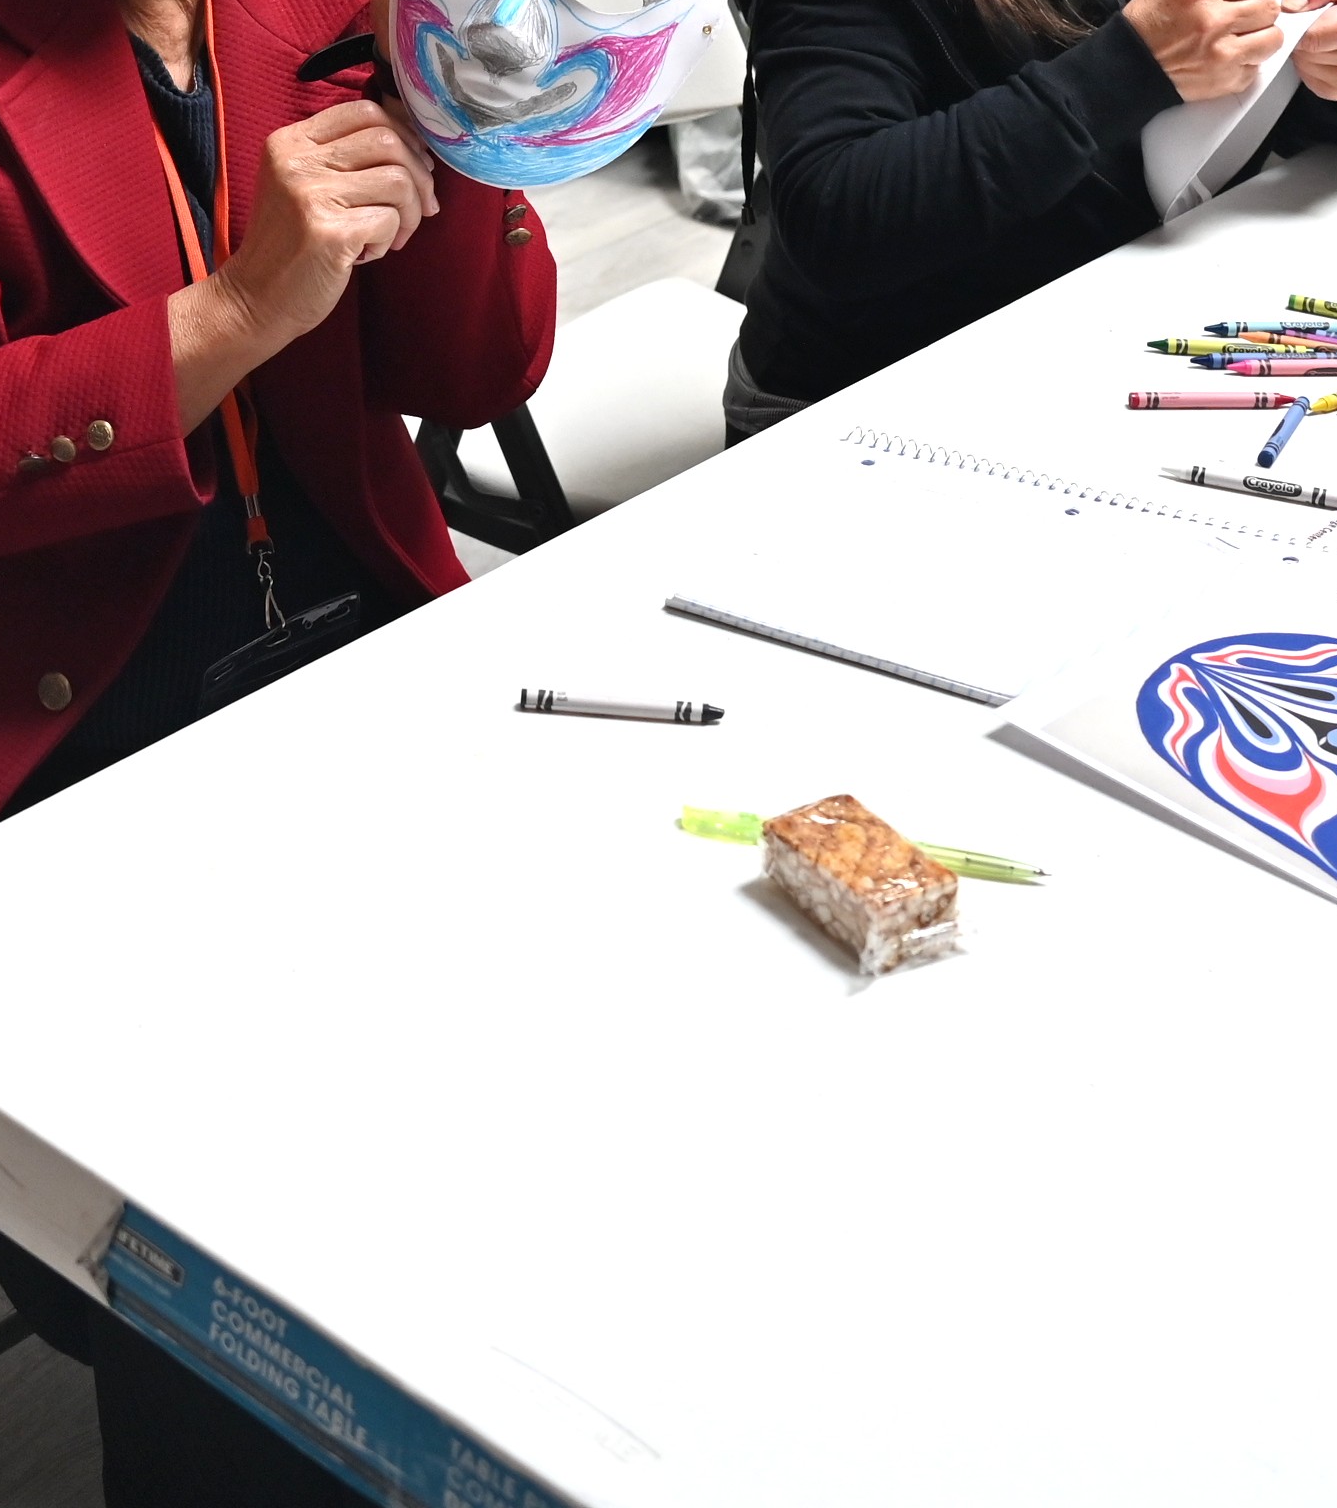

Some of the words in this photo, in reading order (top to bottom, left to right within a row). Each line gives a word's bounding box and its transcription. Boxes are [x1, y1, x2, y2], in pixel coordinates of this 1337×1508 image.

[1246, 477, 1298, 495] Crayola
[1306, 527, 1334, 543] Center
[212, 1275, 288, 1339] 6-FOOT
[209, 1321, 300, 1401] FOLDING
[306, 1391, 369, 1446] TABLE
[210, 1298, 356, 1413] COMMERCIAL
